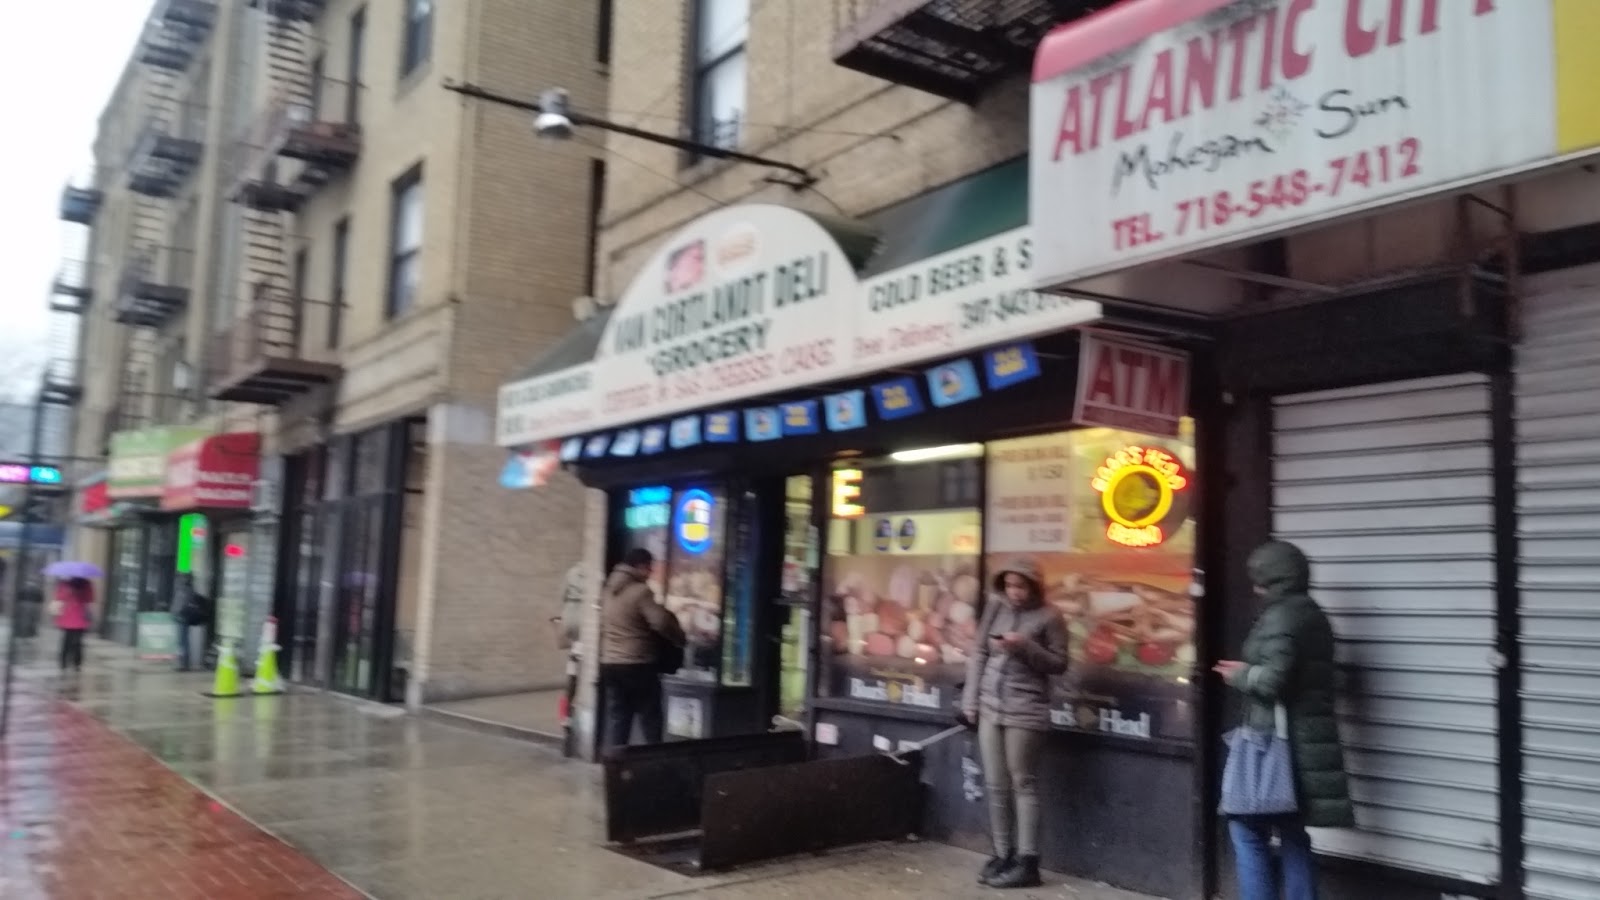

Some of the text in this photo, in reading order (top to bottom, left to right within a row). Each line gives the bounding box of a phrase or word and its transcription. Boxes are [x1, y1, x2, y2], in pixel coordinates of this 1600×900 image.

[1050, 0, 1316, 162] ATLANTIC
[1112, 87, 1411, 196] Mohegan Sun
[1112, 137, 1423, 251] TEL. 718-548-7412
[773, 250, 830, 308] DELI
[868, 273, 922, 313] COLD
[927, 253, 985, 296] BEER
[991, 245, 1010, 278] &
[1086, 344, 1186, 417] ATM
[832, 469, 865, 519] E
[1144, 448, 1187, 490] HEAD
[1099, 707, 1151, 739] Head
